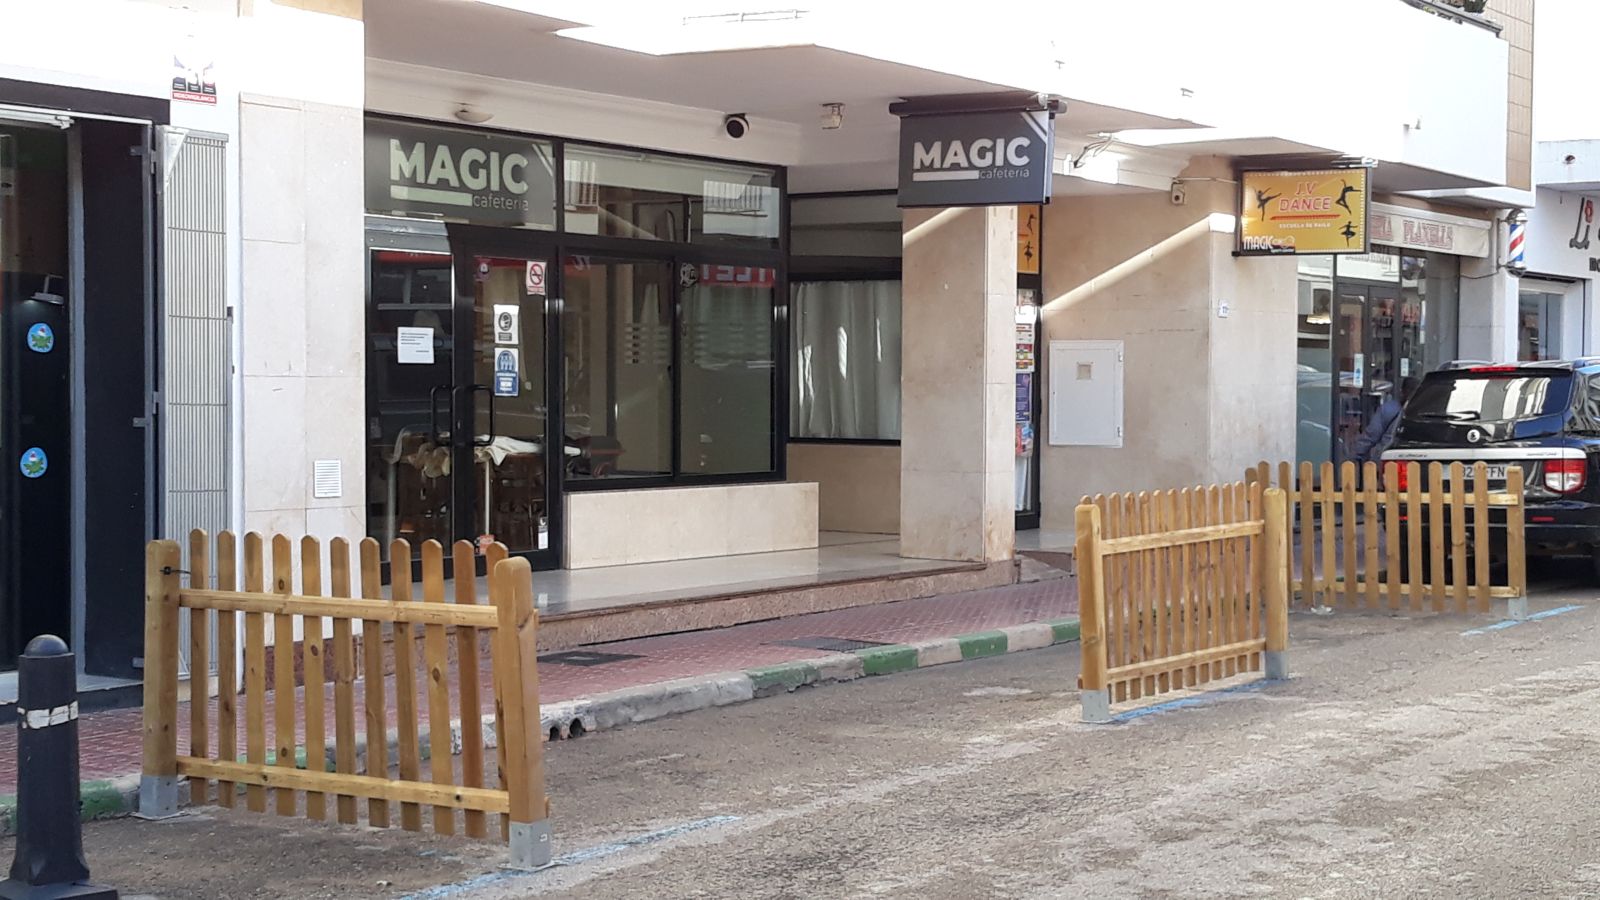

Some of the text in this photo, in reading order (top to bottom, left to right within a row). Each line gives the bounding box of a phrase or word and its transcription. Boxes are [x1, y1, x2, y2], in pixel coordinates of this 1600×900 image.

[390, 138, 529, 195] MAGIC
[912, 136, 1031, 170] MAGIC
[1279, 196, 1331, 212] DANCE
